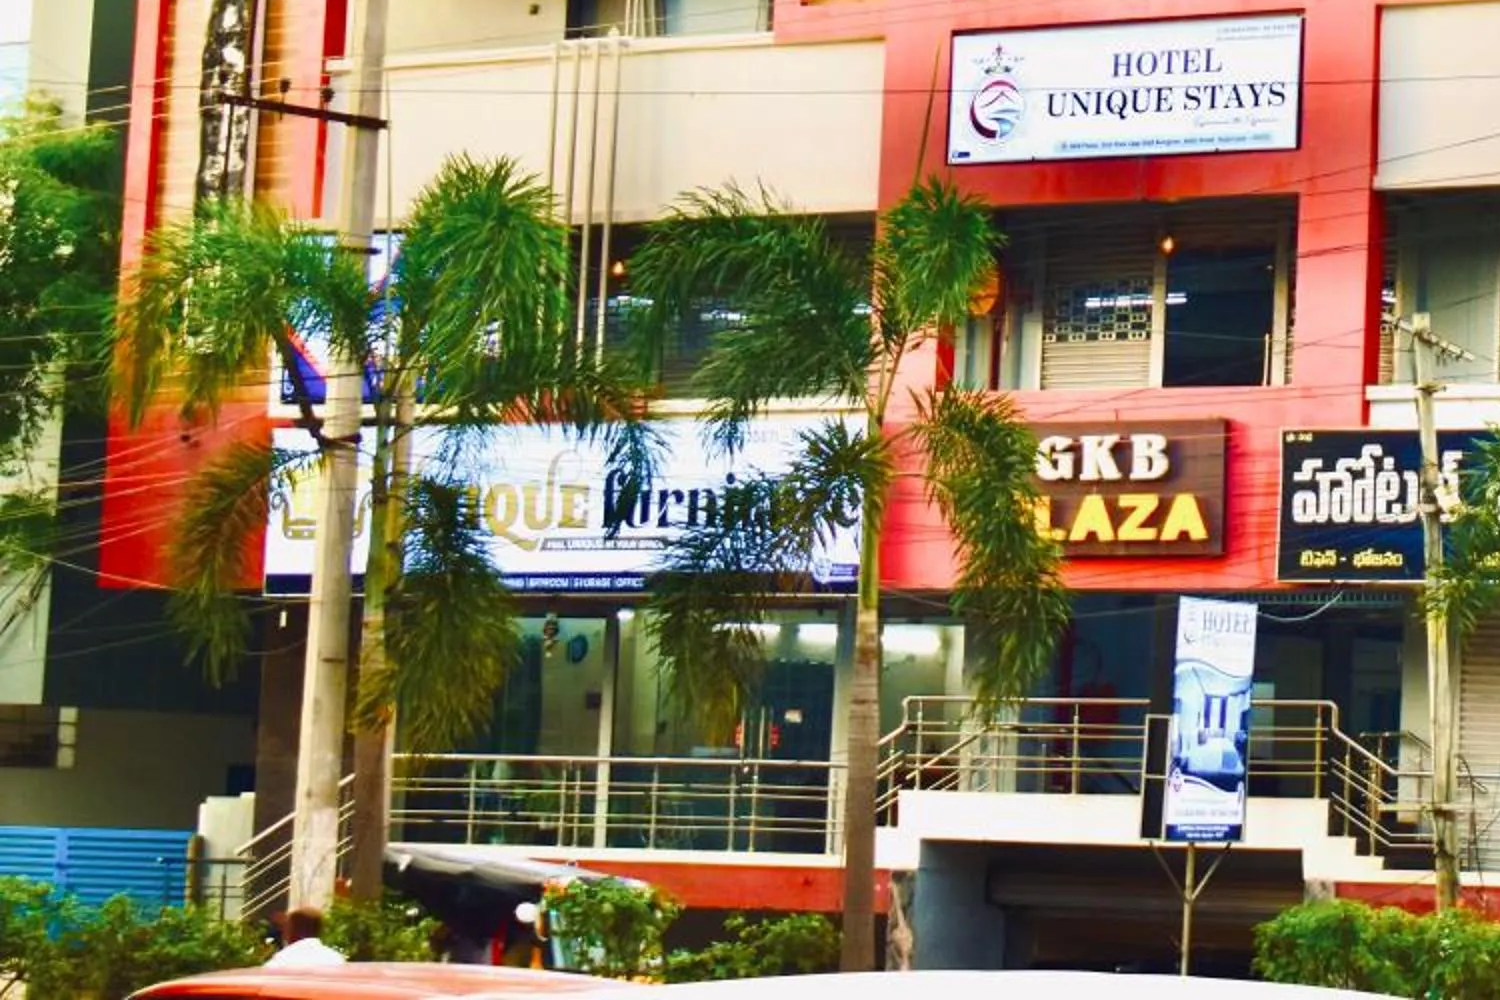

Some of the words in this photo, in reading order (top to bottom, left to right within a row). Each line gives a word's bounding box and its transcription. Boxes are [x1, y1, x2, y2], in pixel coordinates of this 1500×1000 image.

[1112, 48, 1223, 77] HOTEL
[1046, 87, 1173, 120] UNIQUE
[1183, 81, 1286, 110] STAYS
[1036, 434, 1169, 481] GKB
[1015, 493, 1209, 541] LAZA
